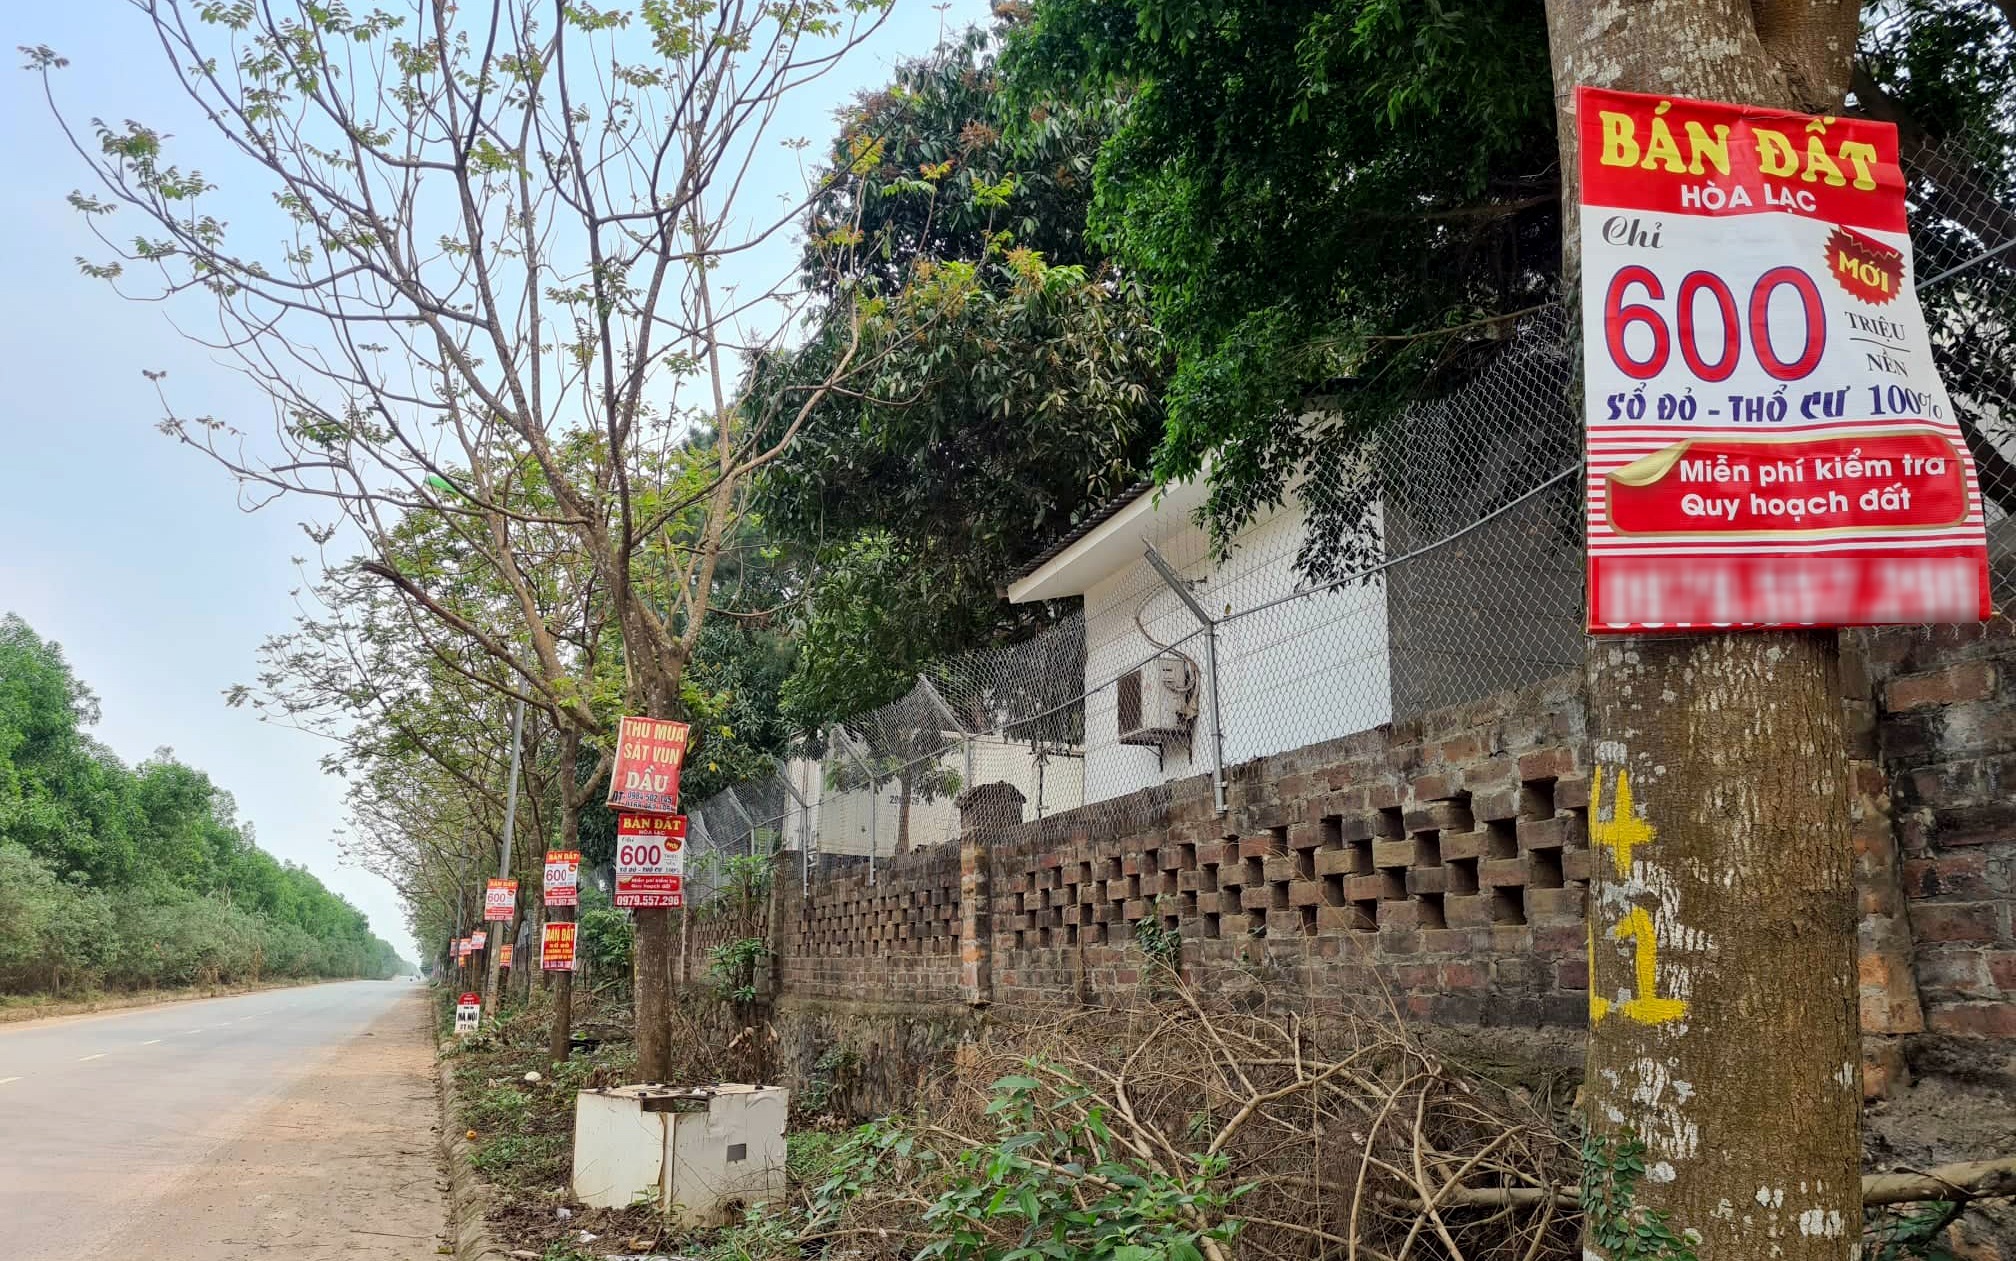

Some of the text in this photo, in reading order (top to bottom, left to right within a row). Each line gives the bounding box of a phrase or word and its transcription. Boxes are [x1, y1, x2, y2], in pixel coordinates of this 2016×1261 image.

[1599, 101, 1877, 191] BÁN ĐẤT
[1681, 181, 1817, 214] HÒA LẠC
[1602, 215, 1664, 248] Chỉ
[1838, 250, 1890, 293] MỚI
[1603, 265, 1827, 383] 600
[1845, 311, 1906, 342] TRIỆU
[1867, 351, 1909, 378] NỀN
[1607, 382, 1647, 421] SỔ
[1657, 387, 1697, 421] ĐỎ
[1728, 384, 1788, 422] THỔ
[1800, 385, 1852, 420] CƯ
[1868, 384, 1944, 420] 100%
[1679, 448, 1946, 487] Miễn phí kiểm tra
[1681, 482, 1911, 522] Quy hoạch đất
[625, 720, 685, 743] THU MUA
[653, 746, 680, 767] VỤN
[625, 765, 669, 792] DẦU
[623, 815, 682, 831] BÁN ĐẤT
[620, 845, 661, 866] 600
[546, 869, 567, 881] 600
[487, 893, 506, 903] 600
